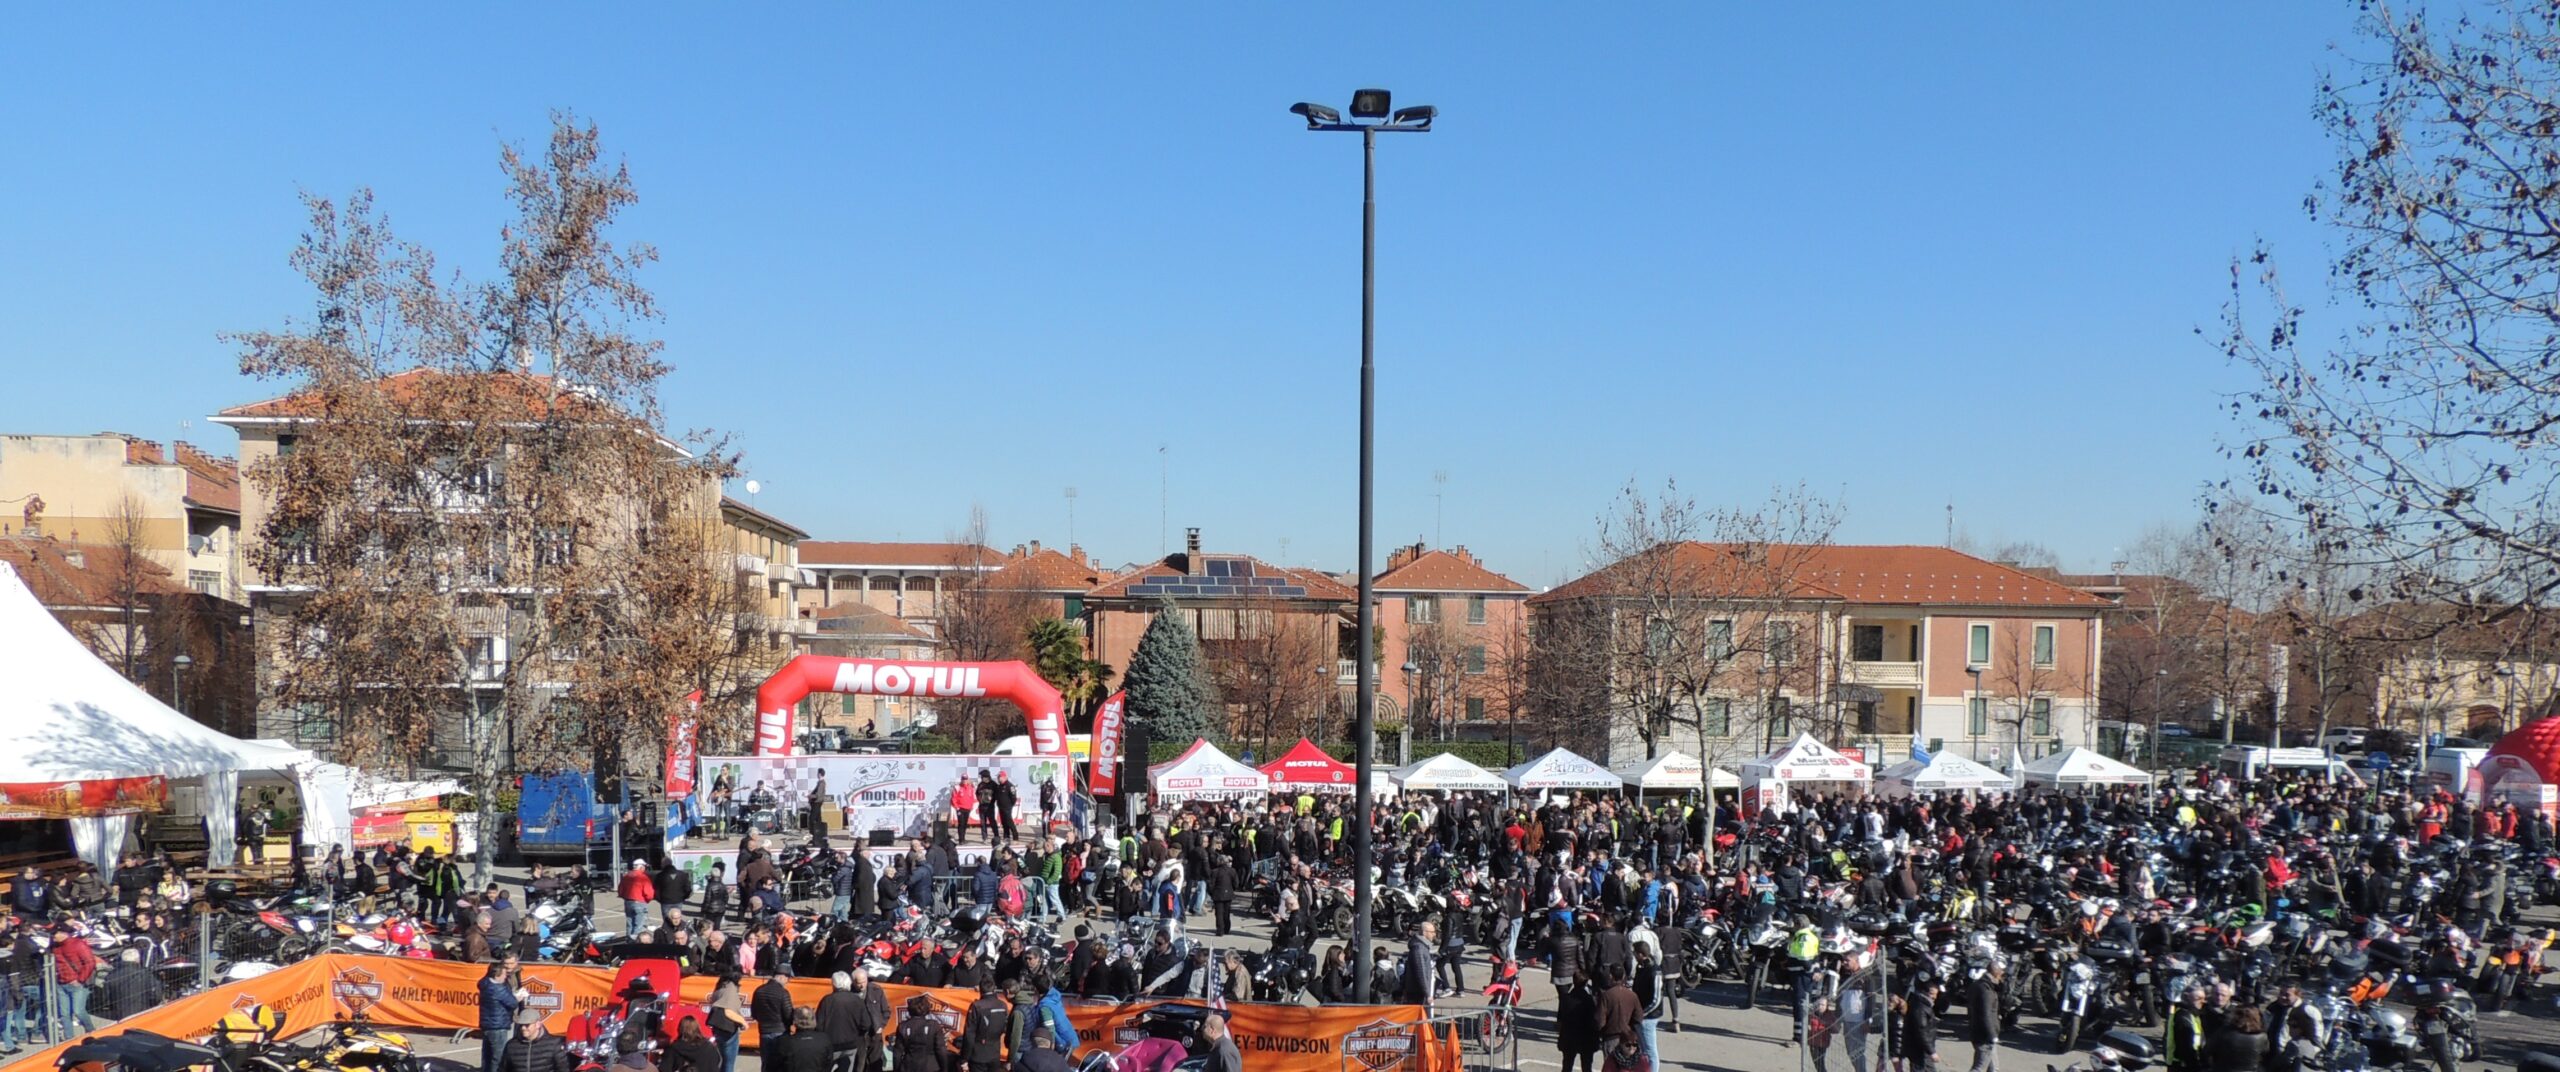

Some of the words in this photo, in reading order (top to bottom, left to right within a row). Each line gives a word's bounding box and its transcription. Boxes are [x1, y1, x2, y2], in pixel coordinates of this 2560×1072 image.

[832, 663, 986, 697] MOTUL
[759, 708, 787, 757] TUL
[1097, 700, 1121, 778] MOTUL
[1285, 760, 1328, 768] MOTUL
[1781, 769, 1792, 778] 58
[1170, 778, 1201, 787] MOTUL
[1225, 777, 1256, 786] MOTUL
[861, 787, 926, 801] motoclub
[392, 986, 480, 1006] HARLEY-DAVIDSO
[1234, 1034, 1330, 1054] EY-DAVIDSON
[1350, 1038, 1411, 1050] HARLEY-DAVIDSON
